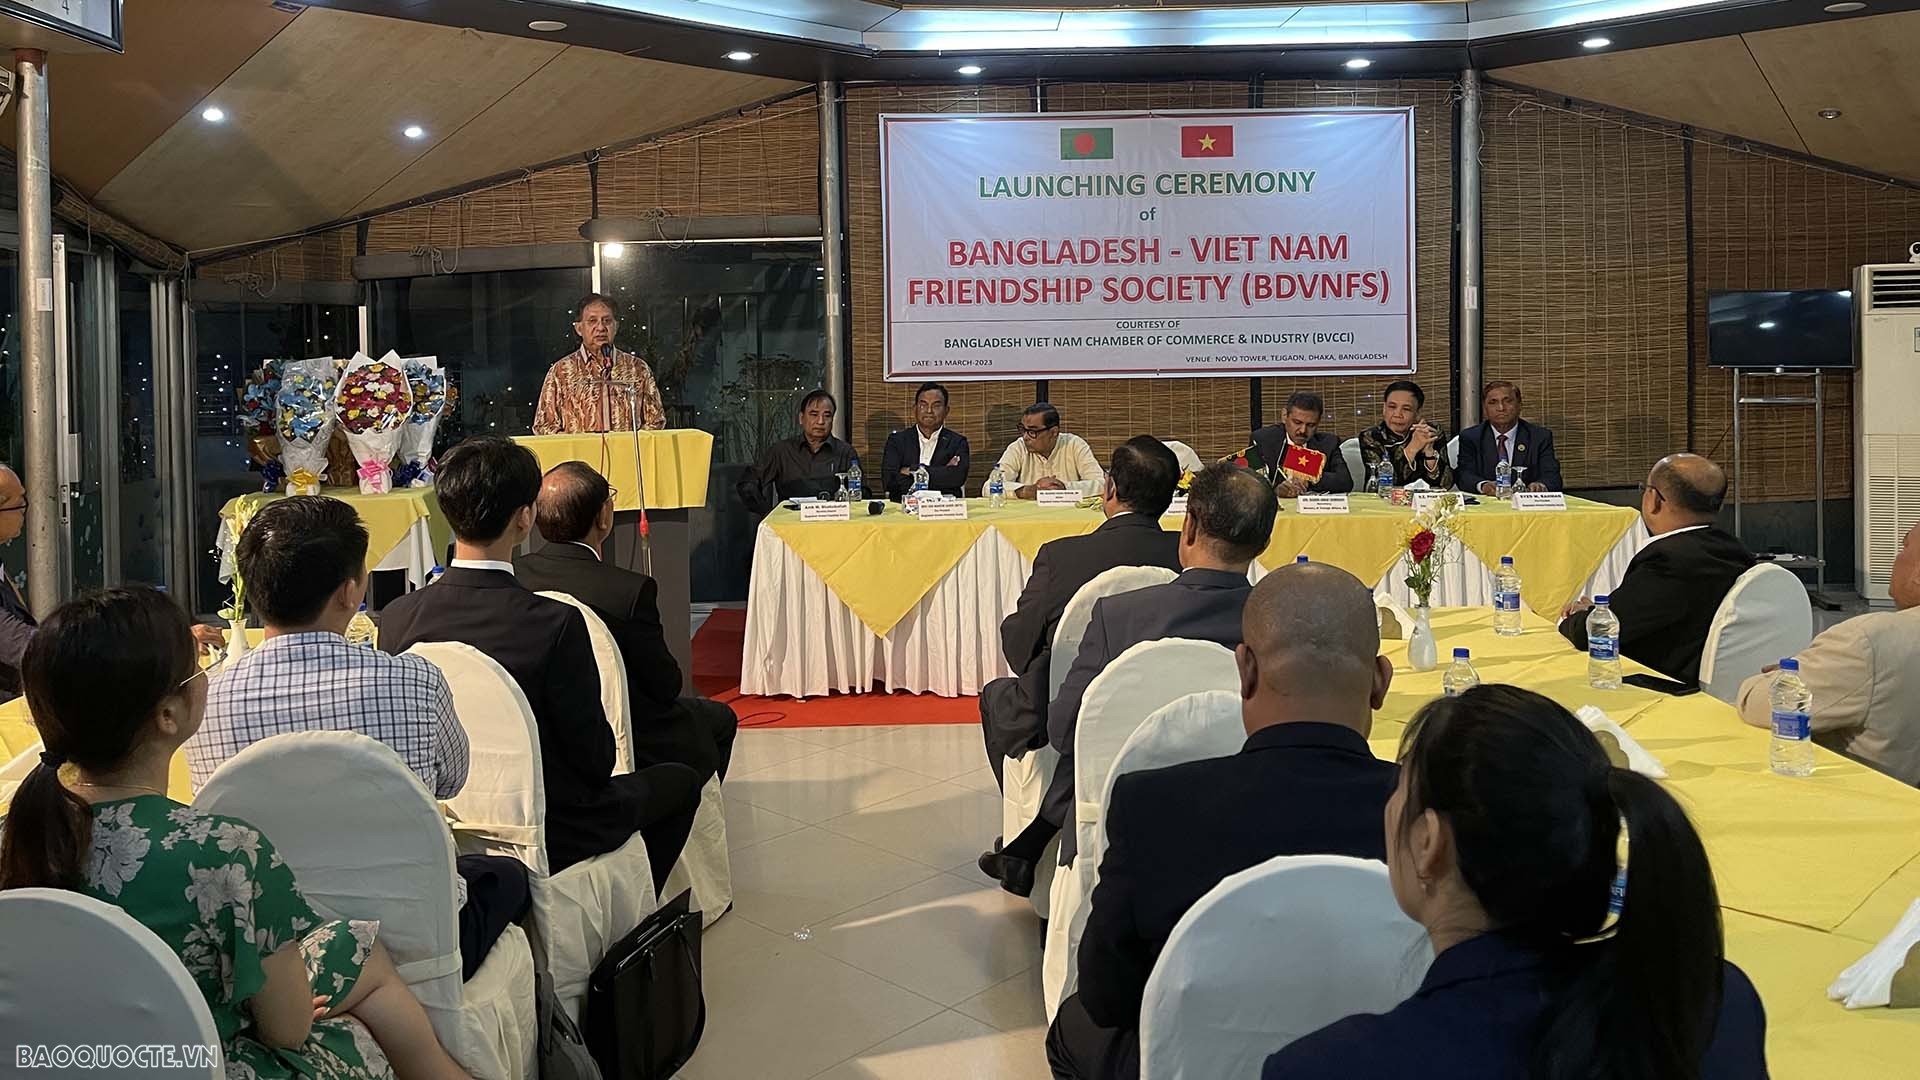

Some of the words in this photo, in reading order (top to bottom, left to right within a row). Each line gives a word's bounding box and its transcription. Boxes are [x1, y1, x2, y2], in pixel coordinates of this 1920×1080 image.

[978, 174, 1147, 199] LAUNCHING
[1155, 170, 1317, 196] CEREMONY
[1139, 206, 1157, 221] of
[949, 238, 1160, 266] BANGLADESH
[1189, 235, 1261, 262] VIET
[1269, 234, 1348, 261] NAM
[908, 276, 1093, 305] FRIENDSHIP
[1102, 274, 1233, 303] SOCIETY
[1241, 270, 1390, 306] (BDVNFS)
[1115, 320, 1165, 330] COURTESY
[1167, 320, 1181, 329] OF
[944, 336, 1021, 349] BANGLADESH
[1024, 336, 1050, 348] VIET
[1053, 336, 1083, 348] NAM
[1085, 335, 1144, 347] CHAMBER
[1147, 335, 1162, 346] OF
[1165, 334, 1235, 346] COMMERCE
[1237, 333, 1248, 345] &
[1250, 332, 1310, 345] INDUSTRY
[1312, 331, 1355, 345] (BVCCI)
[911, 359, 933, 368] DATE:
[934, 359, 943, 367] 13
[944, 358, 993, 367] MARCH-2023
[1185, 356, 1214, 364] VENUE:
[1338, 353, 1388, 361] BANGLADESH
